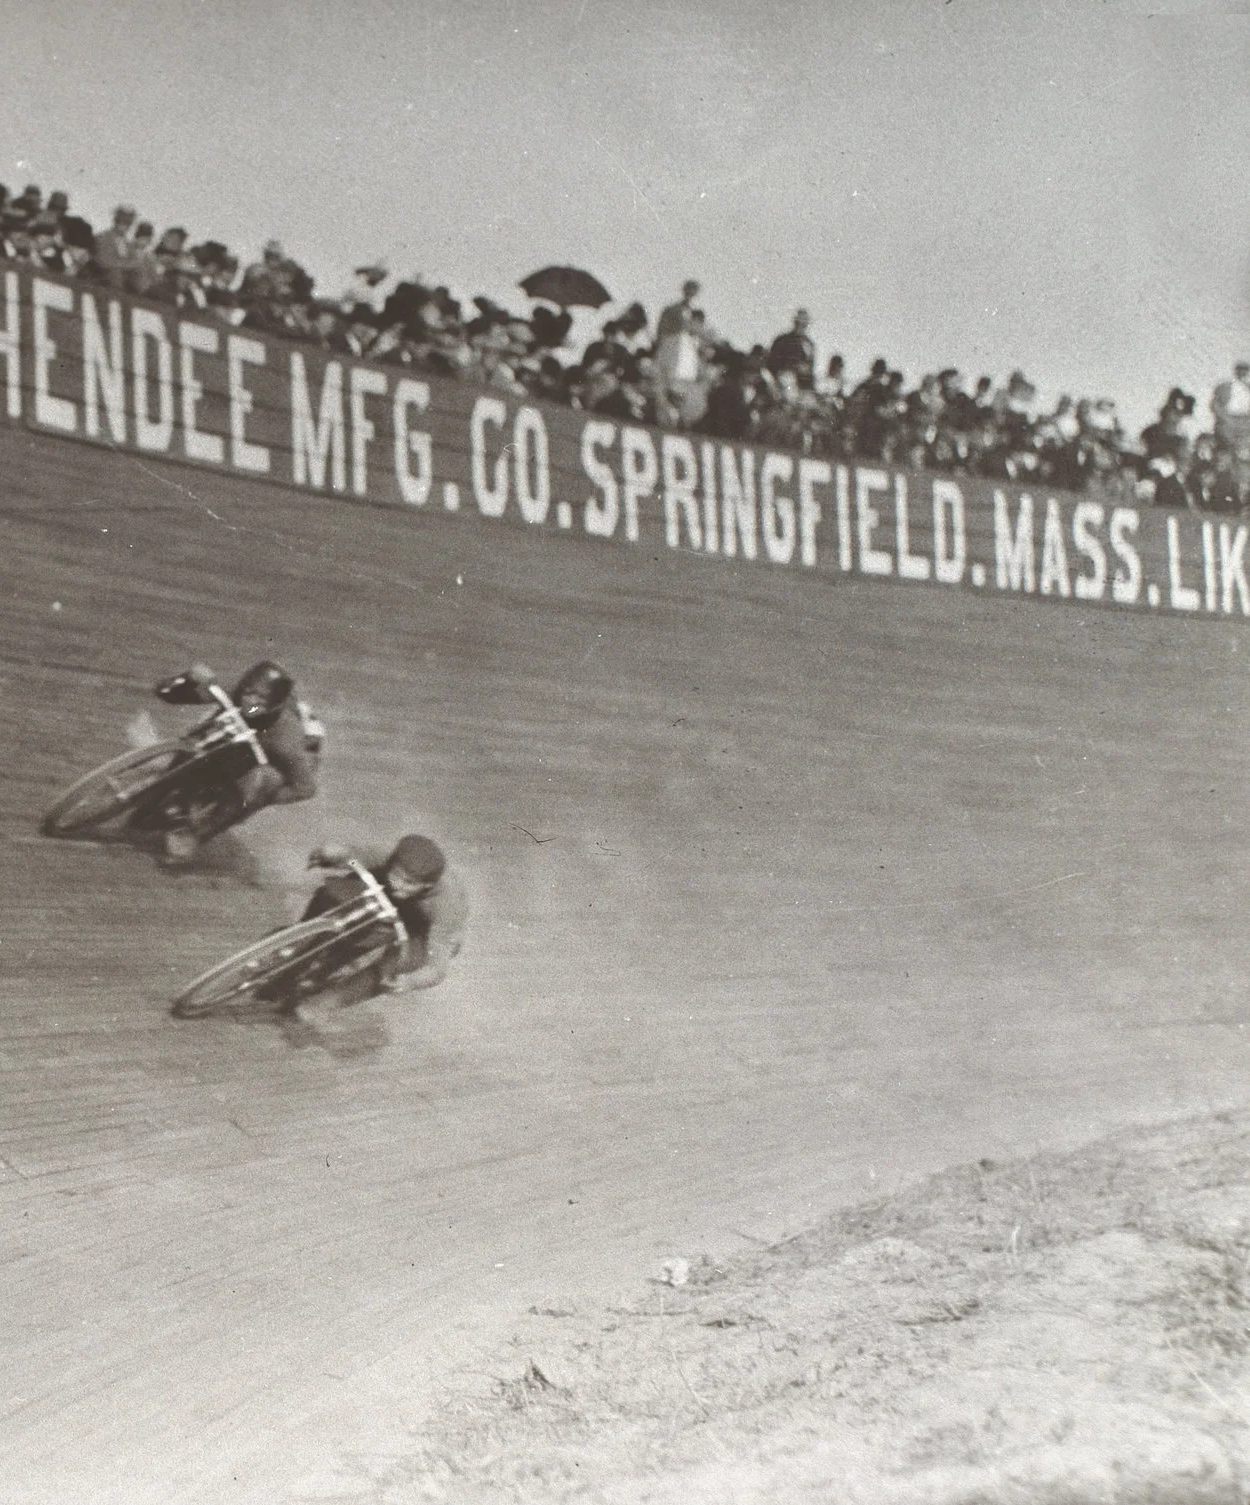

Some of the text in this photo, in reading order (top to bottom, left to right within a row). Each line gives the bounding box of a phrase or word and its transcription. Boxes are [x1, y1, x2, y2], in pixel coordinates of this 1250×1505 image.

[290, 351, 459, 511] MFG.
[471, 396, 572, 529] CO.
[582, 421, 985, 587] SPRINGFIELD.
[993, 489, 1160, 607] MASS.
